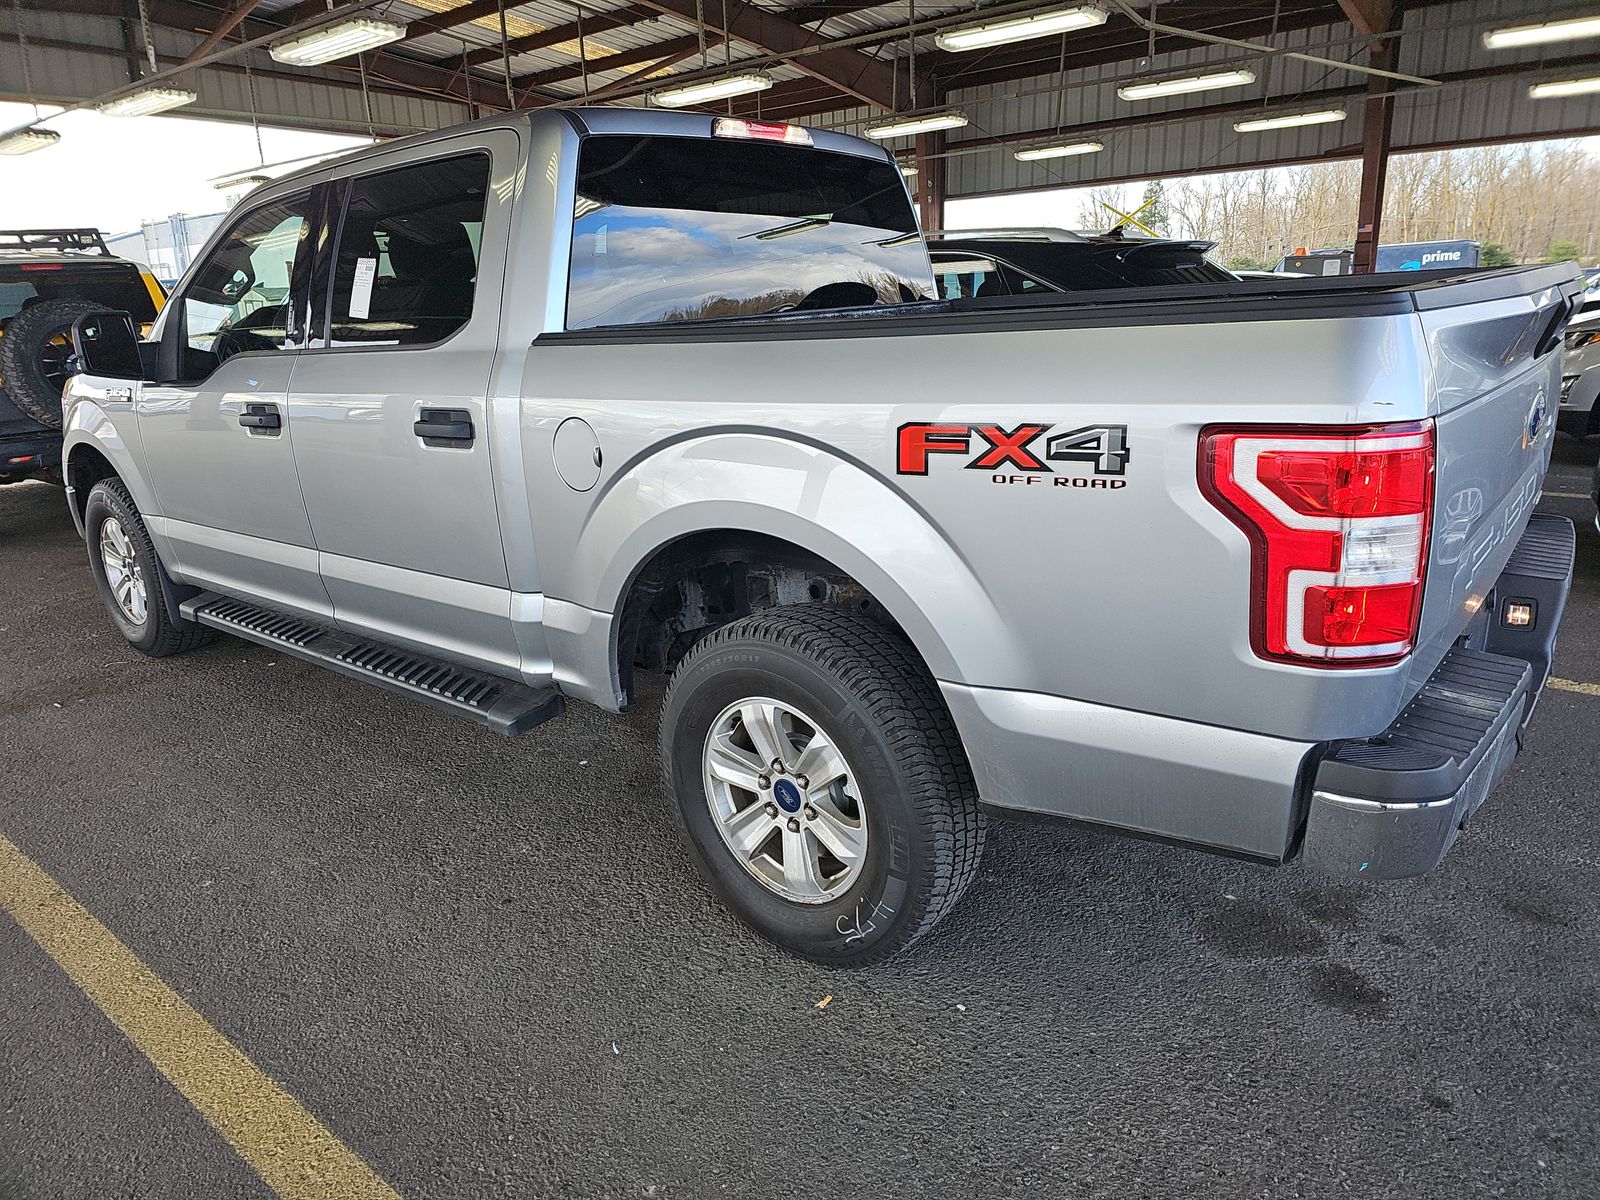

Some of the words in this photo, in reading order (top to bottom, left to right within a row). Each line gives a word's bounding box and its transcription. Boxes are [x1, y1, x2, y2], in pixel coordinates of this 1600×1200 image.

[1421, 250, 1462, 266] prime
[896, 421, 1130, 476] FX4
[992, 474, 1042, 486] OFF
[1053, 476, 1127, 490] ROAD
